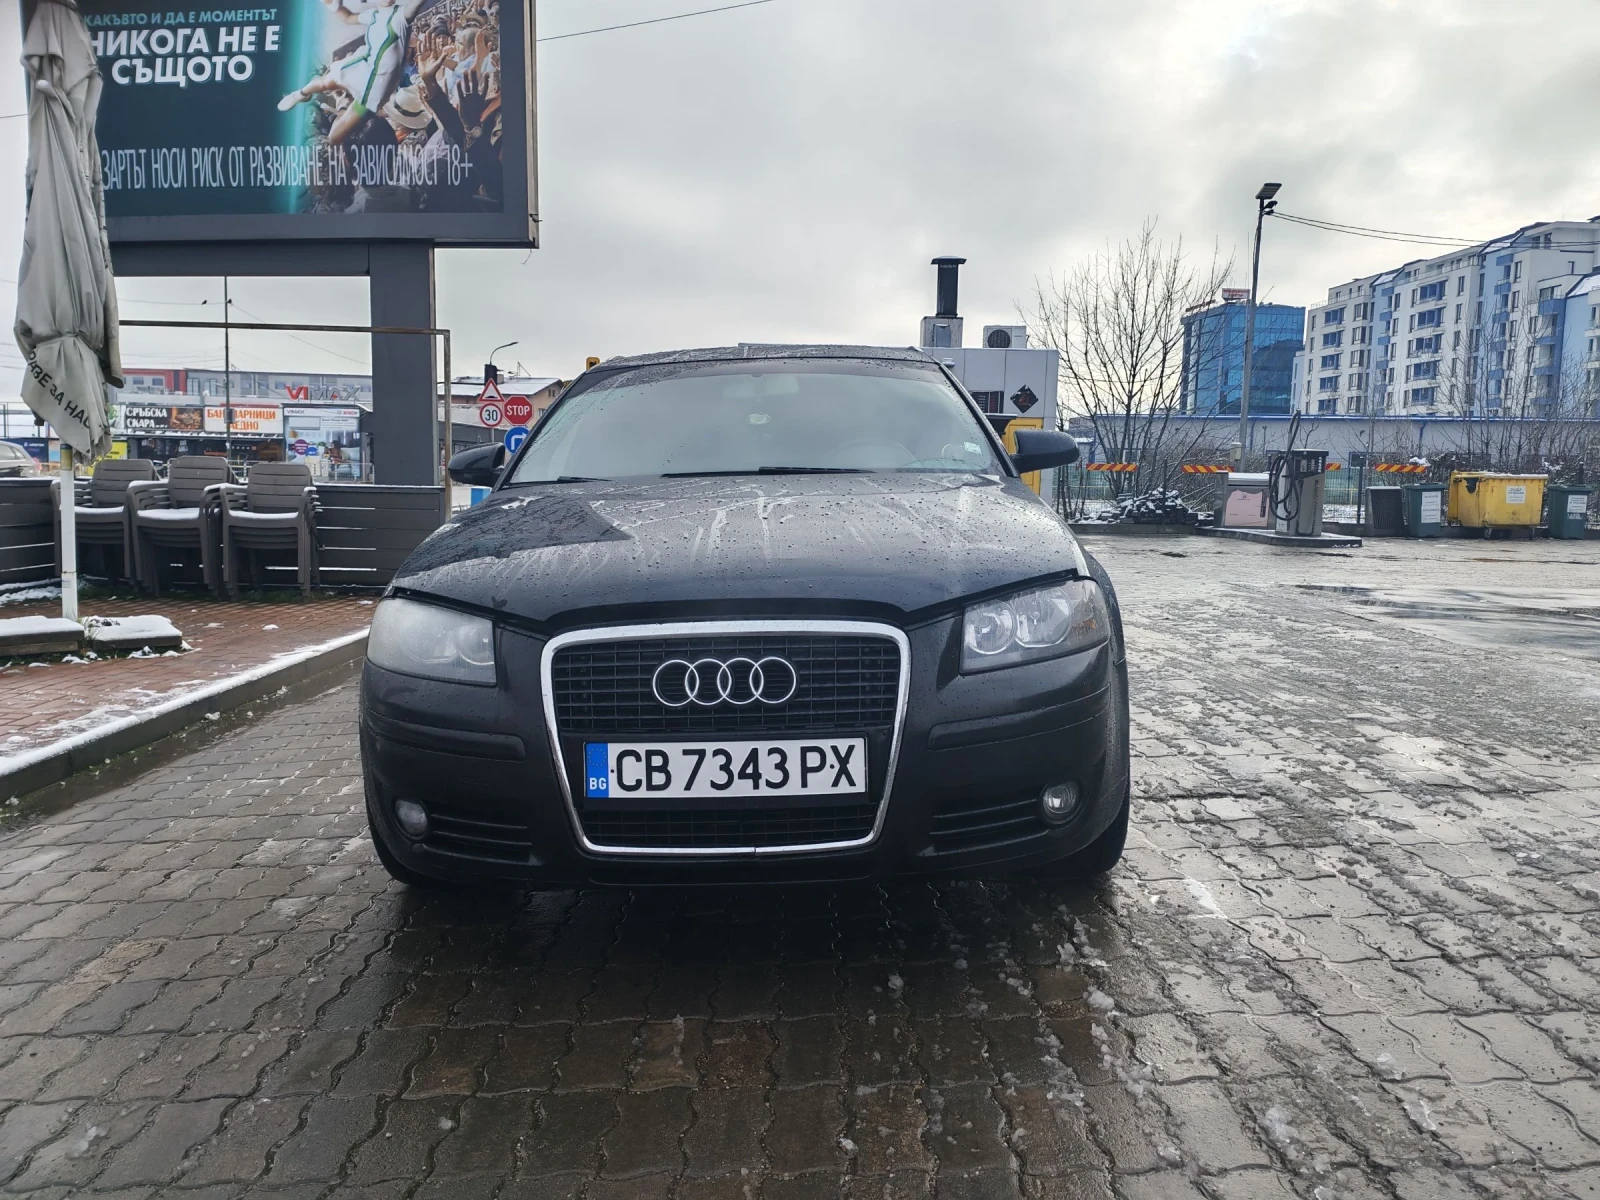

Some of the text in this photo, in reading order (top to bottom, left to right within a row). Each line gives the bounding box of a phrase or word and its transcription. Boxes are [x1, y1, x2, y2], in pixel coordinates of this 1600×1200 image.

[84, 8, 277, 27] КАКЪВТО И ДА Е МОМЕНТЪТ
[89, 25, 281, 57] НИКОГА НЕ Е
[111, 54, 254, 88] СЪЩОТО
[151, 147, 187, 189] НОСИ
[191, 146, 225, 188] РИСК
[228, 146, 245, 187] ОТ
[249, 144, 324, 187] РАЗВИВАНЕ
[328, 144, 348, 187] НА
[350, 144, 439, 187] ЗАВИСИМОСТ
[446, 143, 474, 187] 18+
[49, 383, 65, 406] ЗА
[284, 385, 361, 401] VIMAX
[126, 407, 168, 418] СРЪБСКА
[484, 409, 498, 422] 30
[506, 405, 531, 416] STOP
[616, 744, 857, 792] CB 7343 PX
[589, 777, 607, 791] BG
